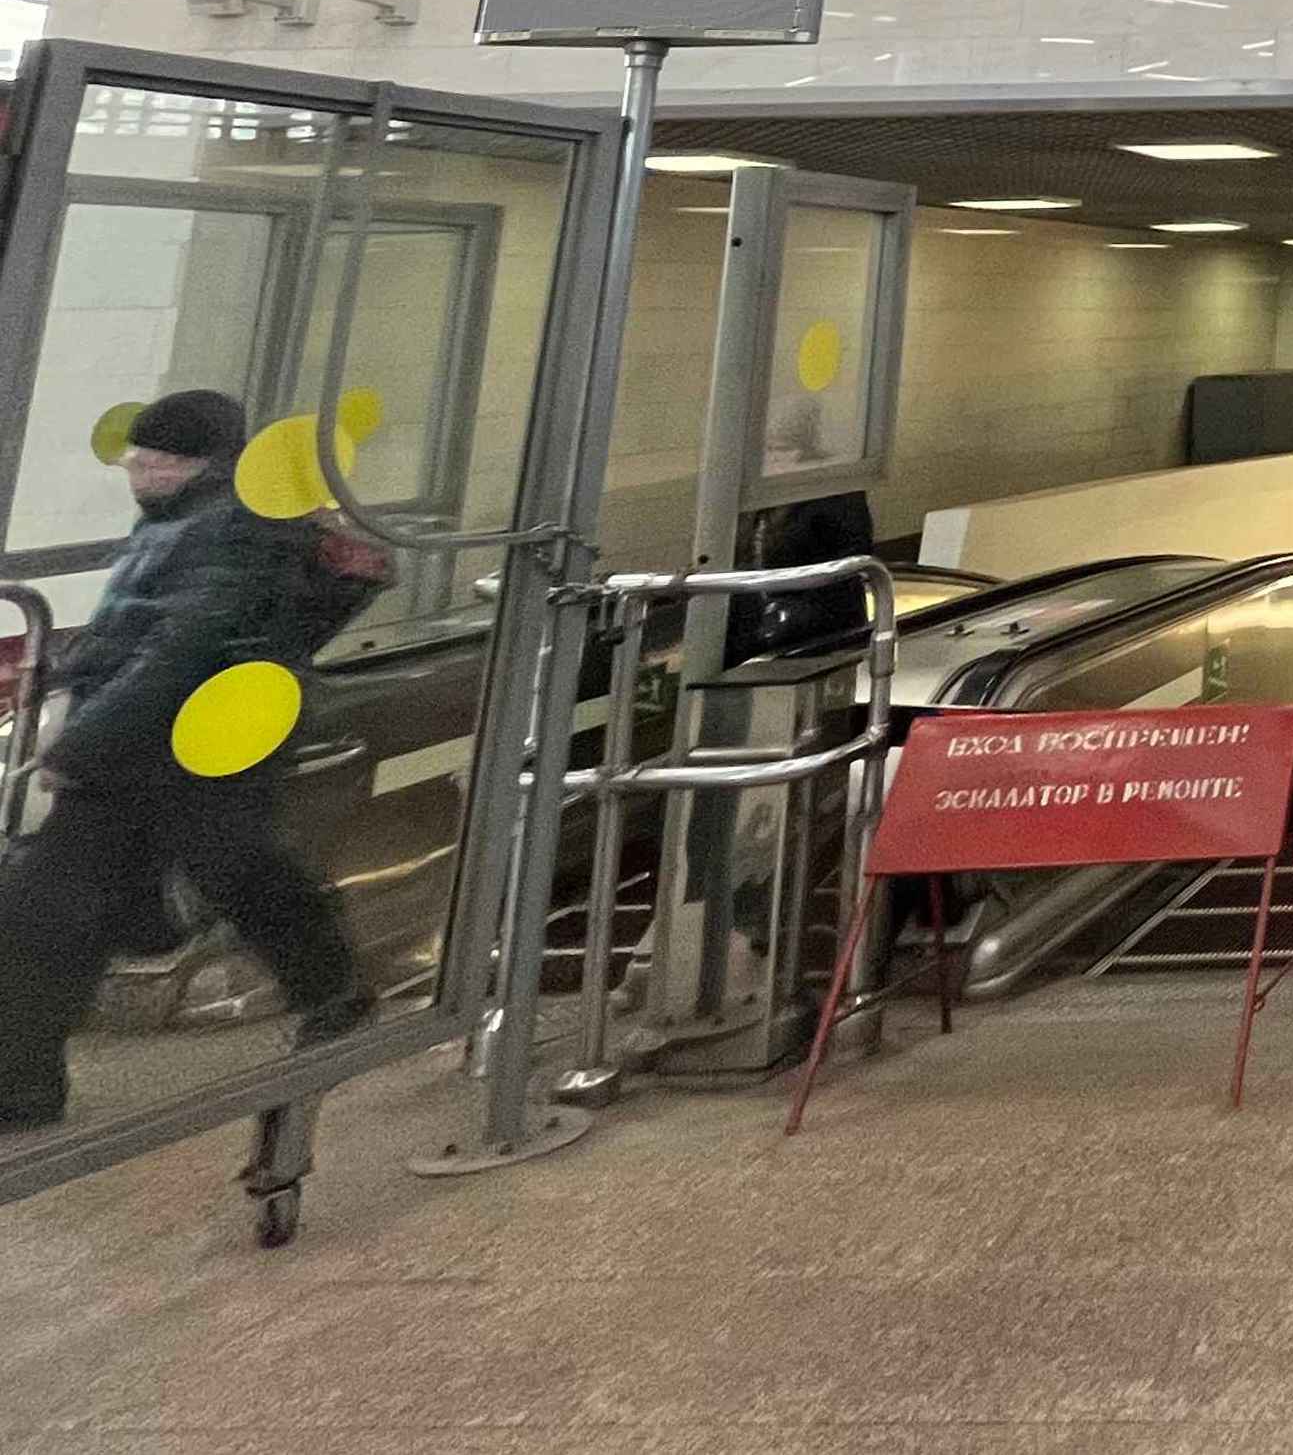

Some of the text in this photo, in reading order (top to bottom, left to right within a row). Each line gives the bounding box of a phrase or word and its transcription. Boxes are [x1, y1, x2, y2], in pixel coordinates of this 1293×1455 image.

[934, 776, 1245, 811] ЭСКАЛАТОР В РЕМОНТЕ
